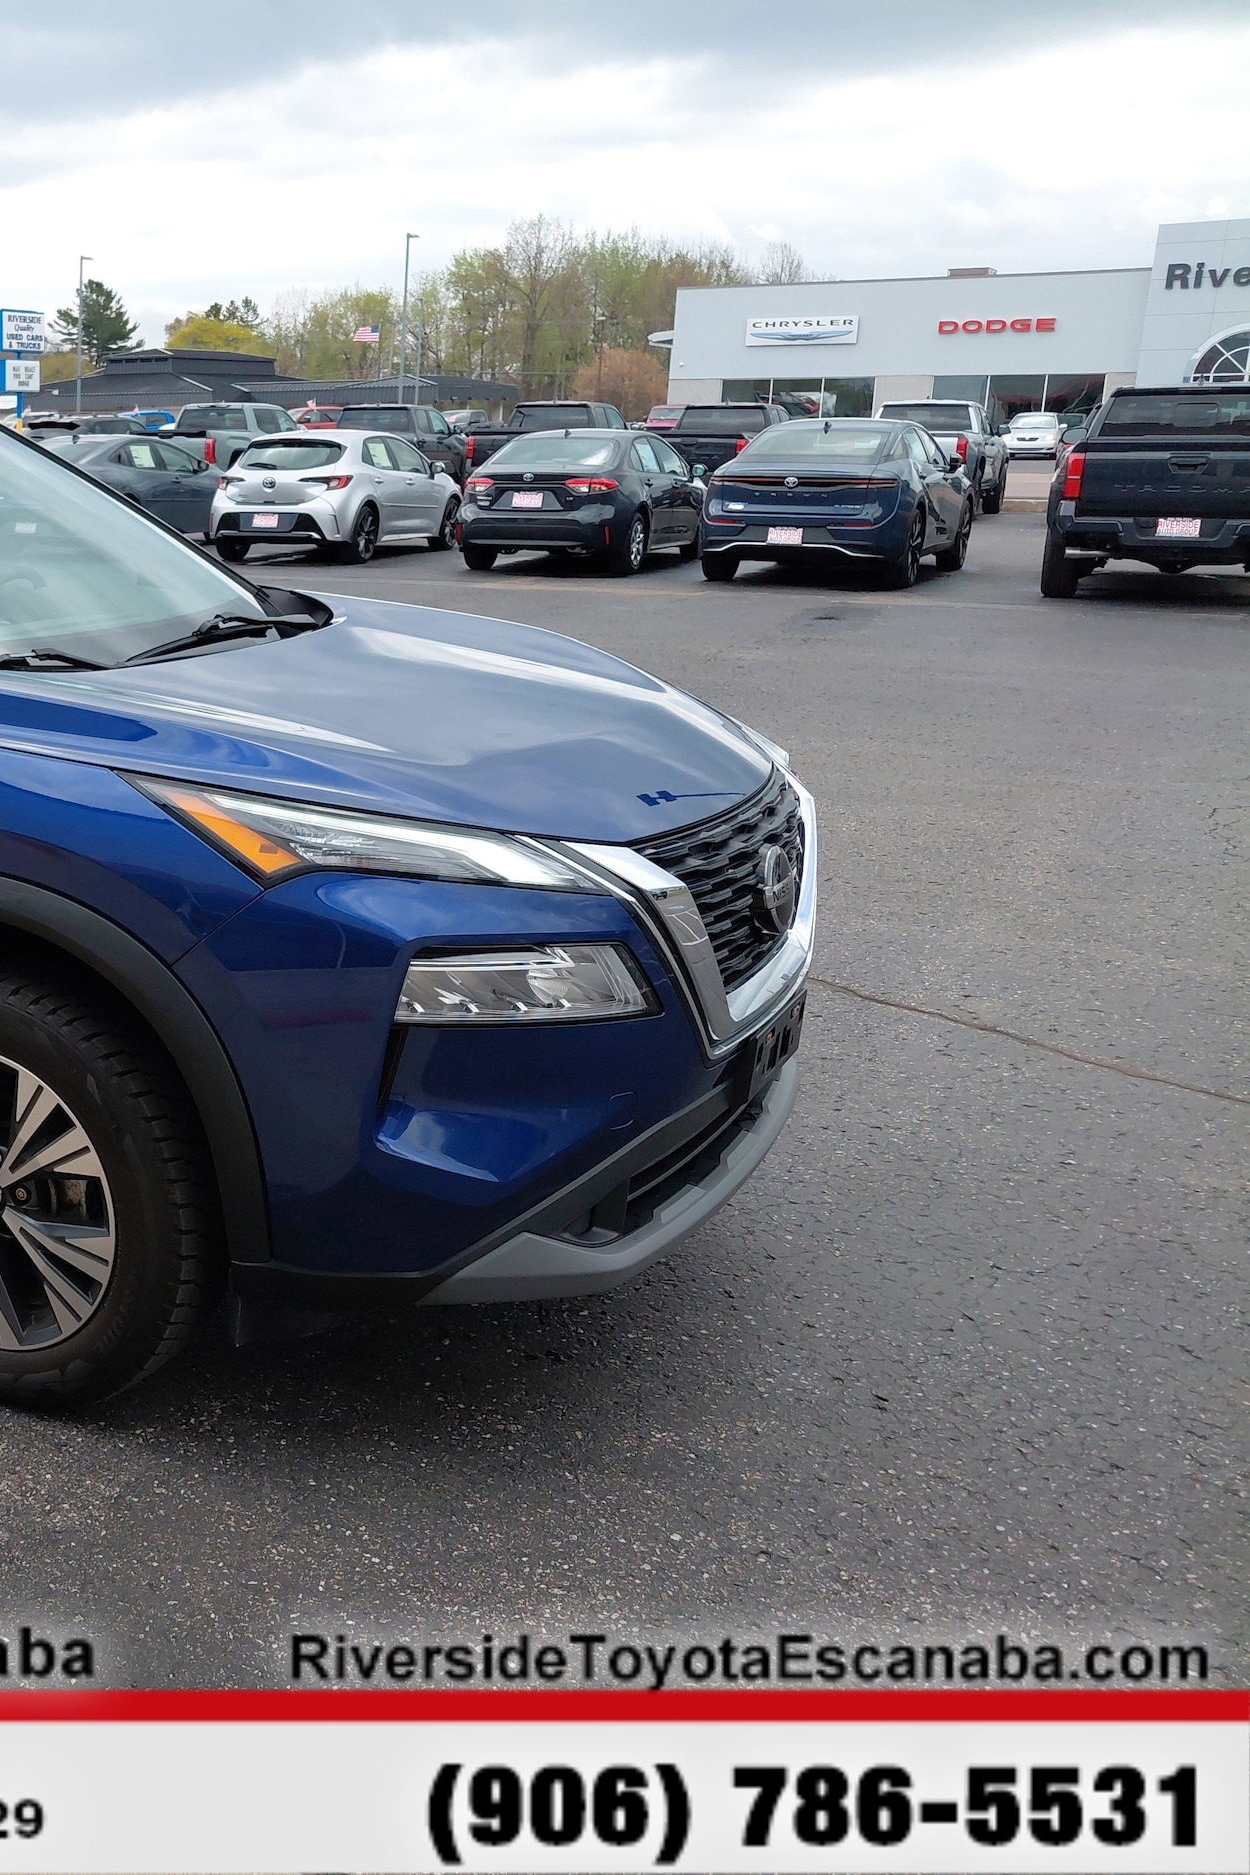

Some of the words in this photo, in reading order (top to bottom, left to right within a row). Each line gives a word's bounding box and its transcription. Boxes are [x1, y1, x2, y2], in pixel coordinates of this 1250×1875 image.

[8, 314, 42, 324] RIVERSIDE
[752, 319, 854, 329] CHRYSLER
[937, 317, 1056, 335] DODGE
[14, 324, 35, 333] Quality
[26, 334, 43, 342] CARS
[16, 341, 41, 349] TRUCKS
[1157, 520, 1199, 528] RIVERSIDE
[769, 529, 802, 537] RIVERSIDE
